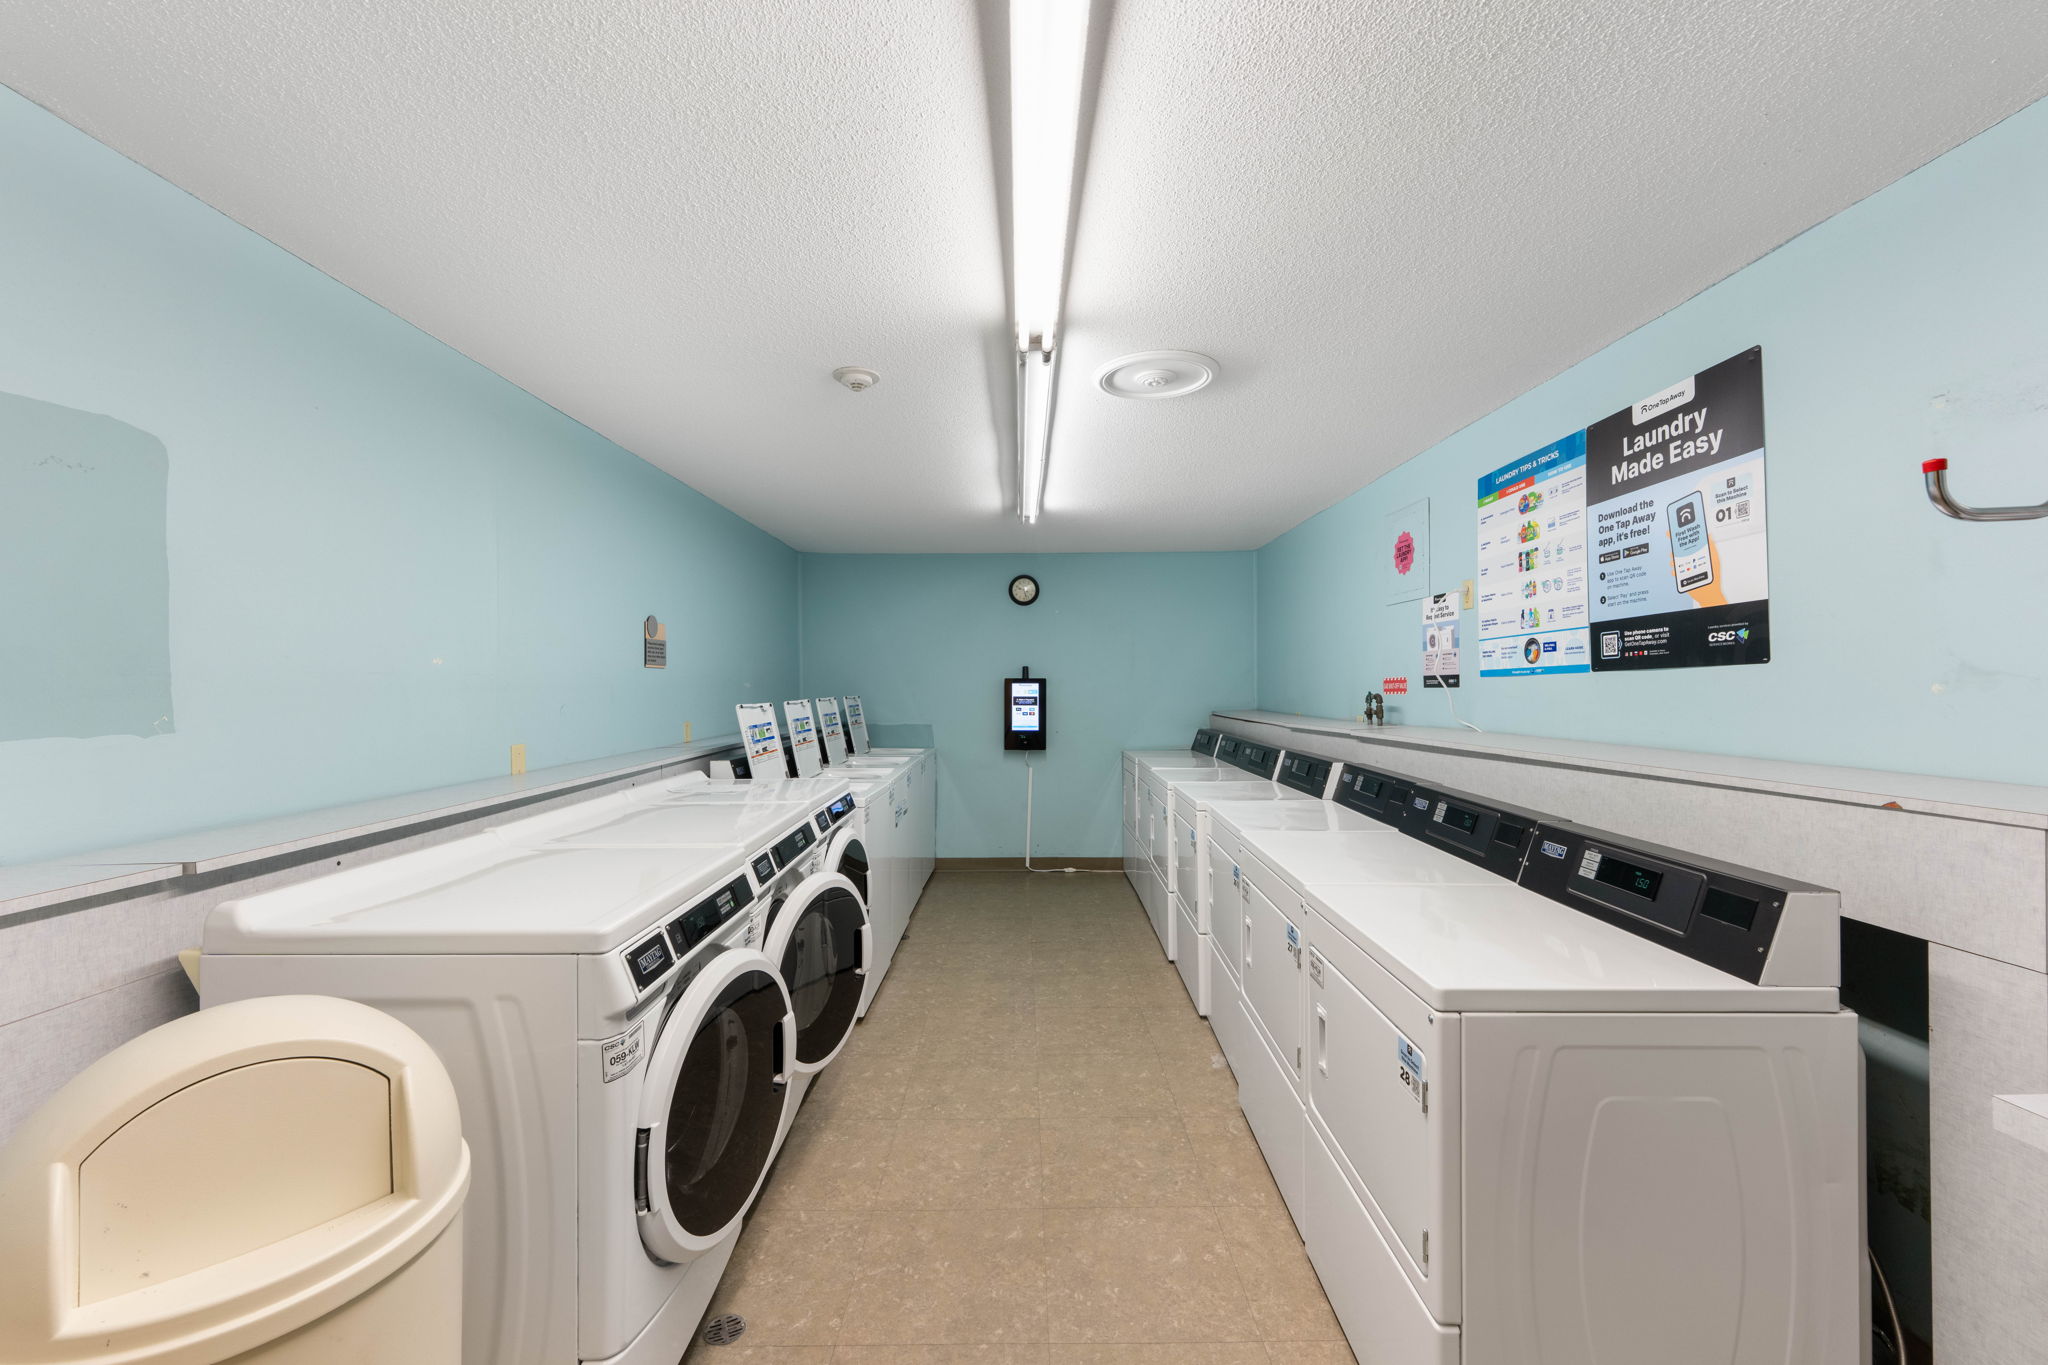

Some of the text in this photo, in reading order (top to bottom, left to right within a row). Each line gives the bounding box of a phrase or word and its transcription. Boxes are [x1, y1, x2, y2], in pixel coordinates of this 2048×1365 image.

[1648, 390, 1685, 411] One Tap Away
[1623, 407, 1707, 457] Laundry
[1495, 450, 1559, 484] LAUNDRY TIPS & TRICKS
[1611, 452, 1664, 485] Made
[1669, 429, 1724, 464] Easy
[1726, 492, 1747, 502] Machine
[1732, 485, 1748, 494] Select
[1598, 503, 1638, 523] Download
[1639, 499, 1654, 510] the
[1715, 507, 1732, 523] 01
[1598, 512, 1657, 535] One Tap Away
[1675, 524, 1700, 538] First Wash
[1598, 525, 1651, 548] app, it's free!
[1708, 630, 1736, 642] CSC
[1543, 842, 1566, 855] MAYTAG
[640, 946, 662, 969] MAYTAG
[1400, 1065, 1410, 1086] 28
